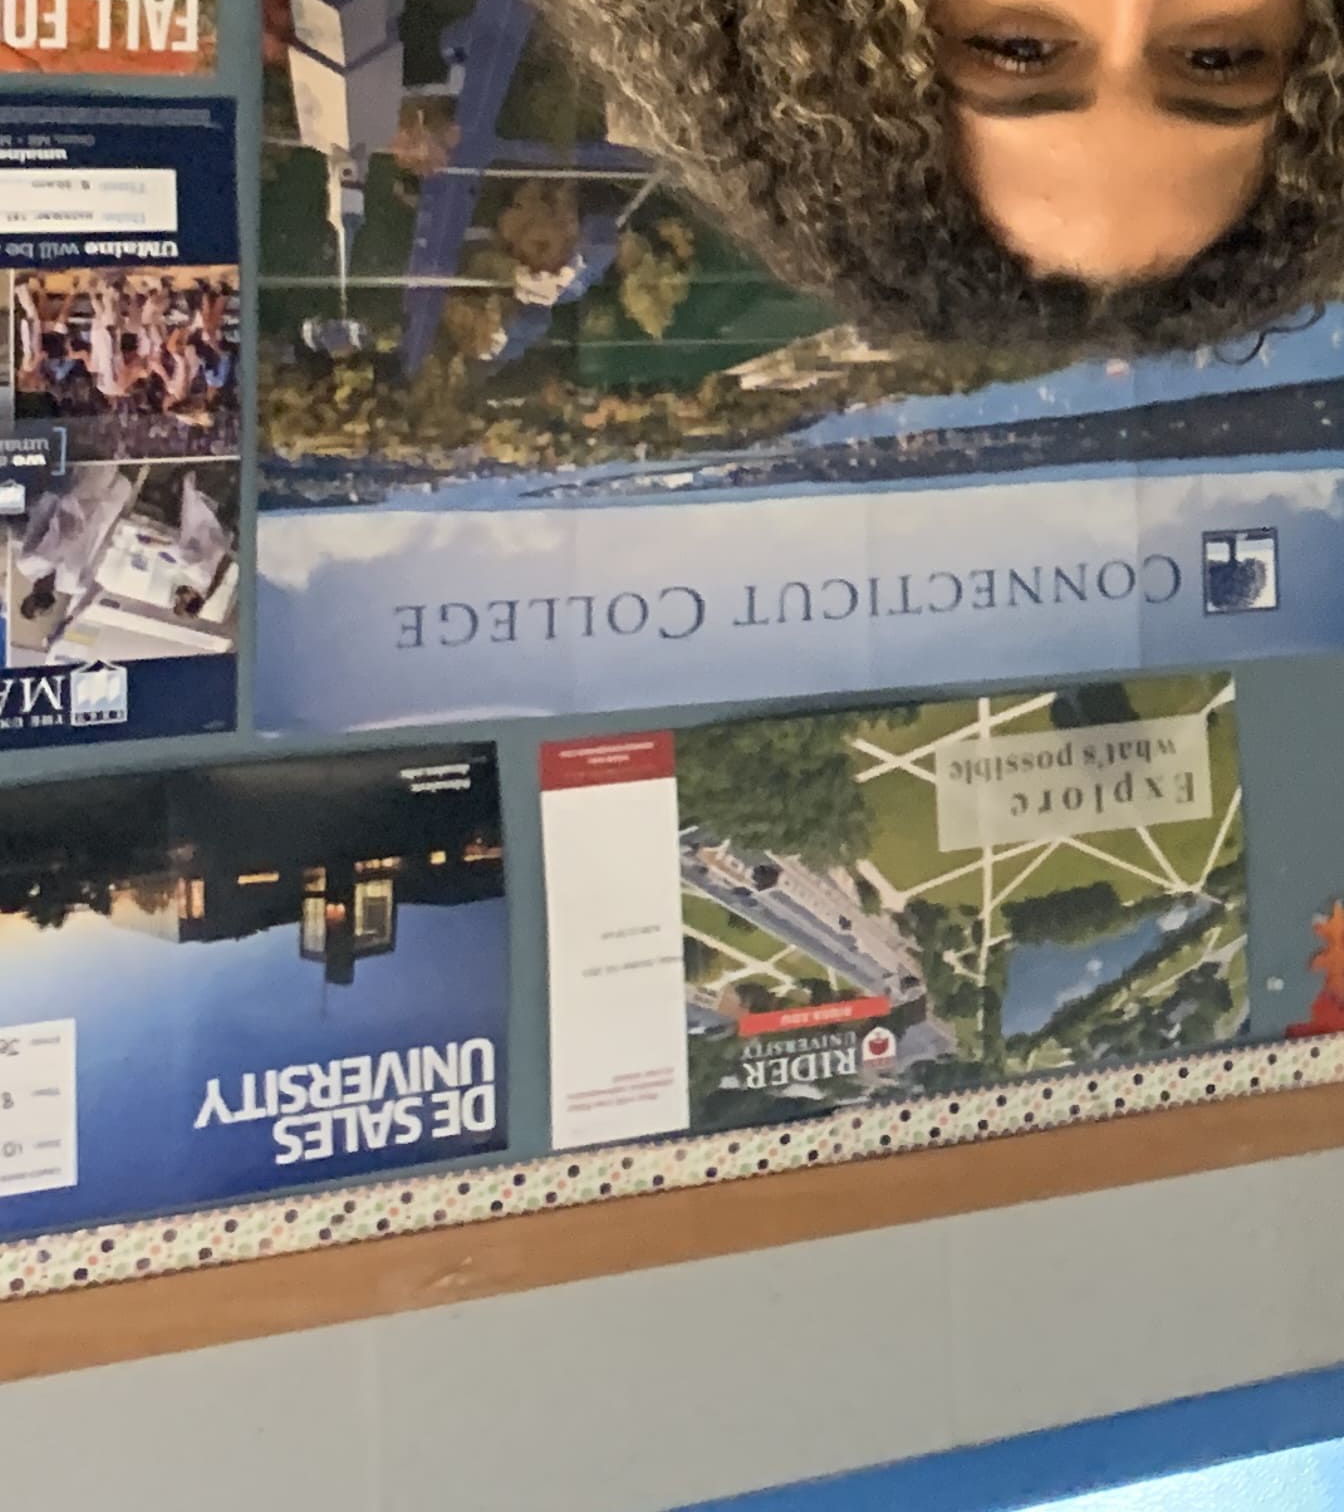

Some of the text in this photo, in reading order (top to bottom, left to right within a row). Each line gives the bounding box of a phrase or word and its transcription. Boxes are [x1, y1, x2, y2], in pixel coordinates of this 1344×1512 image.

[4, 240, 179, 260] UMaine will be
[391, 554, 1181, 649] CONNECTICUT COLLEGE
[948, 738, 1176, 784] what's possible
[1010, 772, 1195, 817] Explore
[740, 1031, 857, 1060] UNIVERSITY
[742, 1047, 857, 1089] RIDER
[193, 1037, 495, 1130] UNIVERSITY
[272, 1084, 496, 1165] DE SALES
